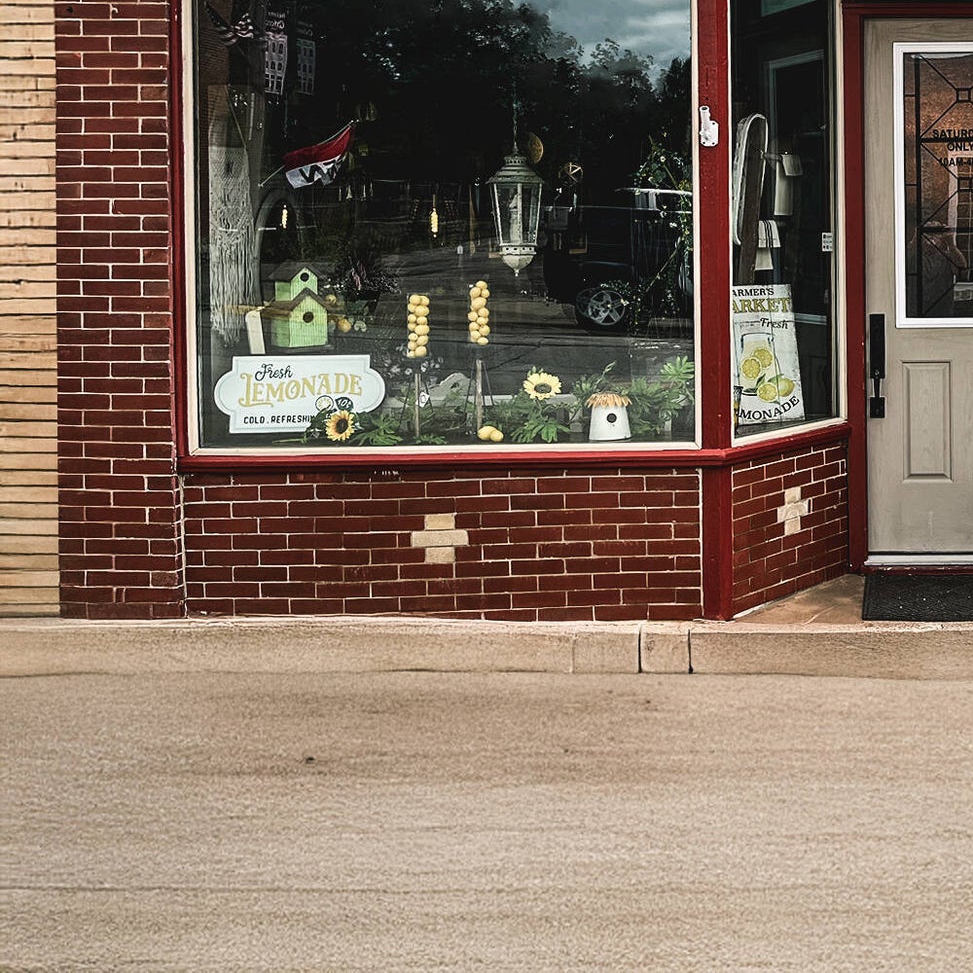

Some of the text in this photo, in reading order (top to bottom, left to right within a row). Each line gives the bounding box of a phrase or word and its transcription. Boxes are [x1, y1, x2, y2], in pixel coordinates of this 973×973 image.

[760, 317, 788, 329] Fresh
[254, 363, 294, 382] Fresh
[238, 372, 363, 408] LEMONADE
[737, 395, 800, 420] MONADE
